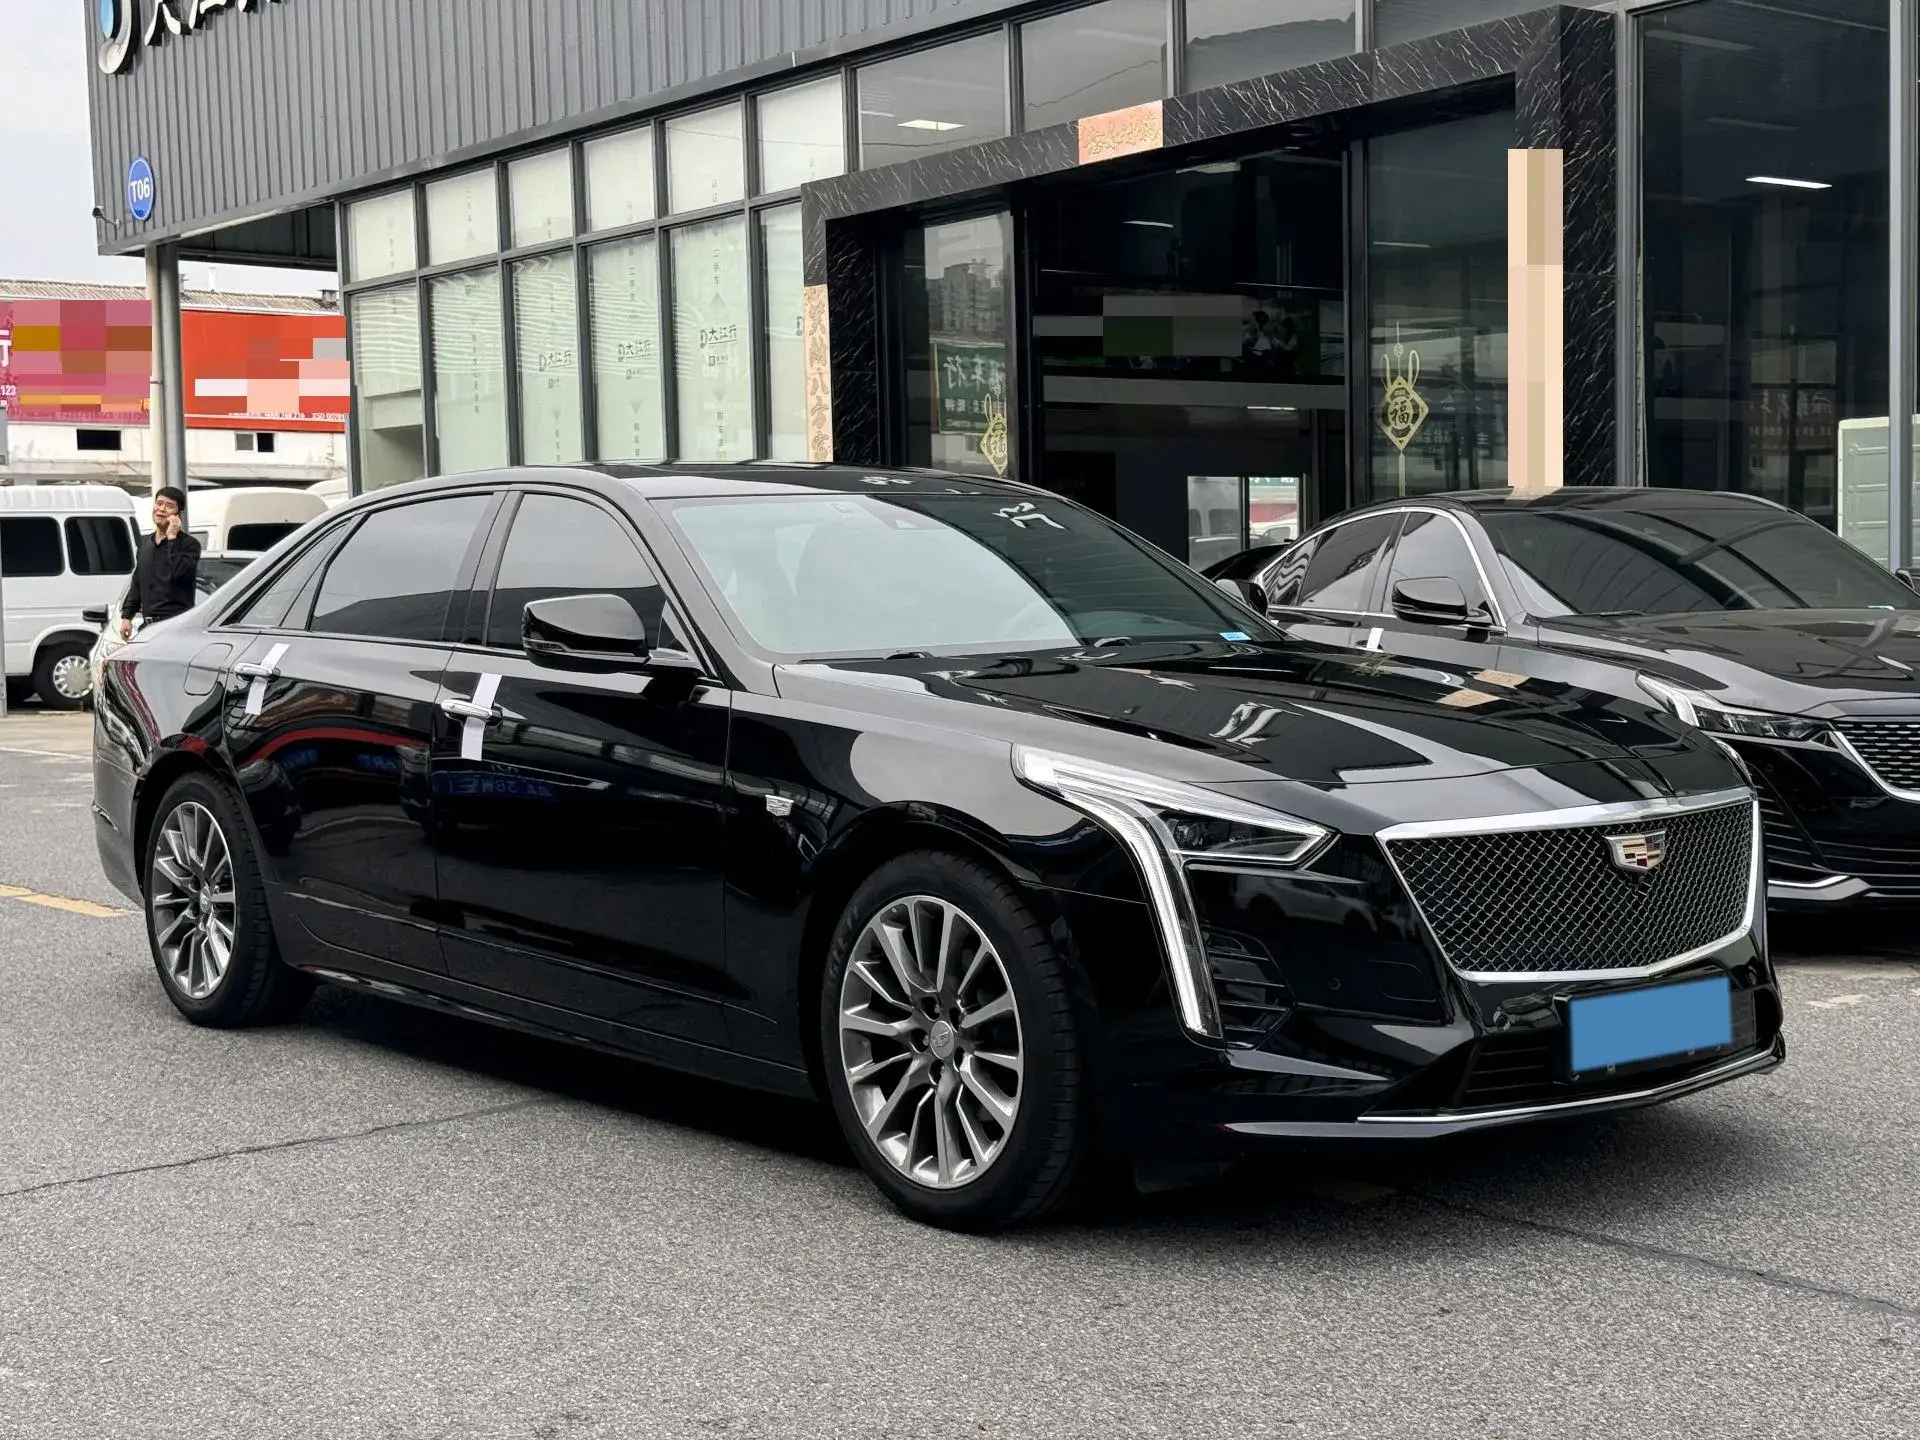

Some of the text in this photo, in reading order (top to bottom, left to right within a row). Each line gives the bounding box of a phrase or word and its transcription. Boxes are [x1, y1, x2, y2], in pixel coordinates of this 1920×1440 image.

[131, 176, 150, 203] T06
[0, 384, 16, 396] 123
[1390, 399, 1410, 426] 福
